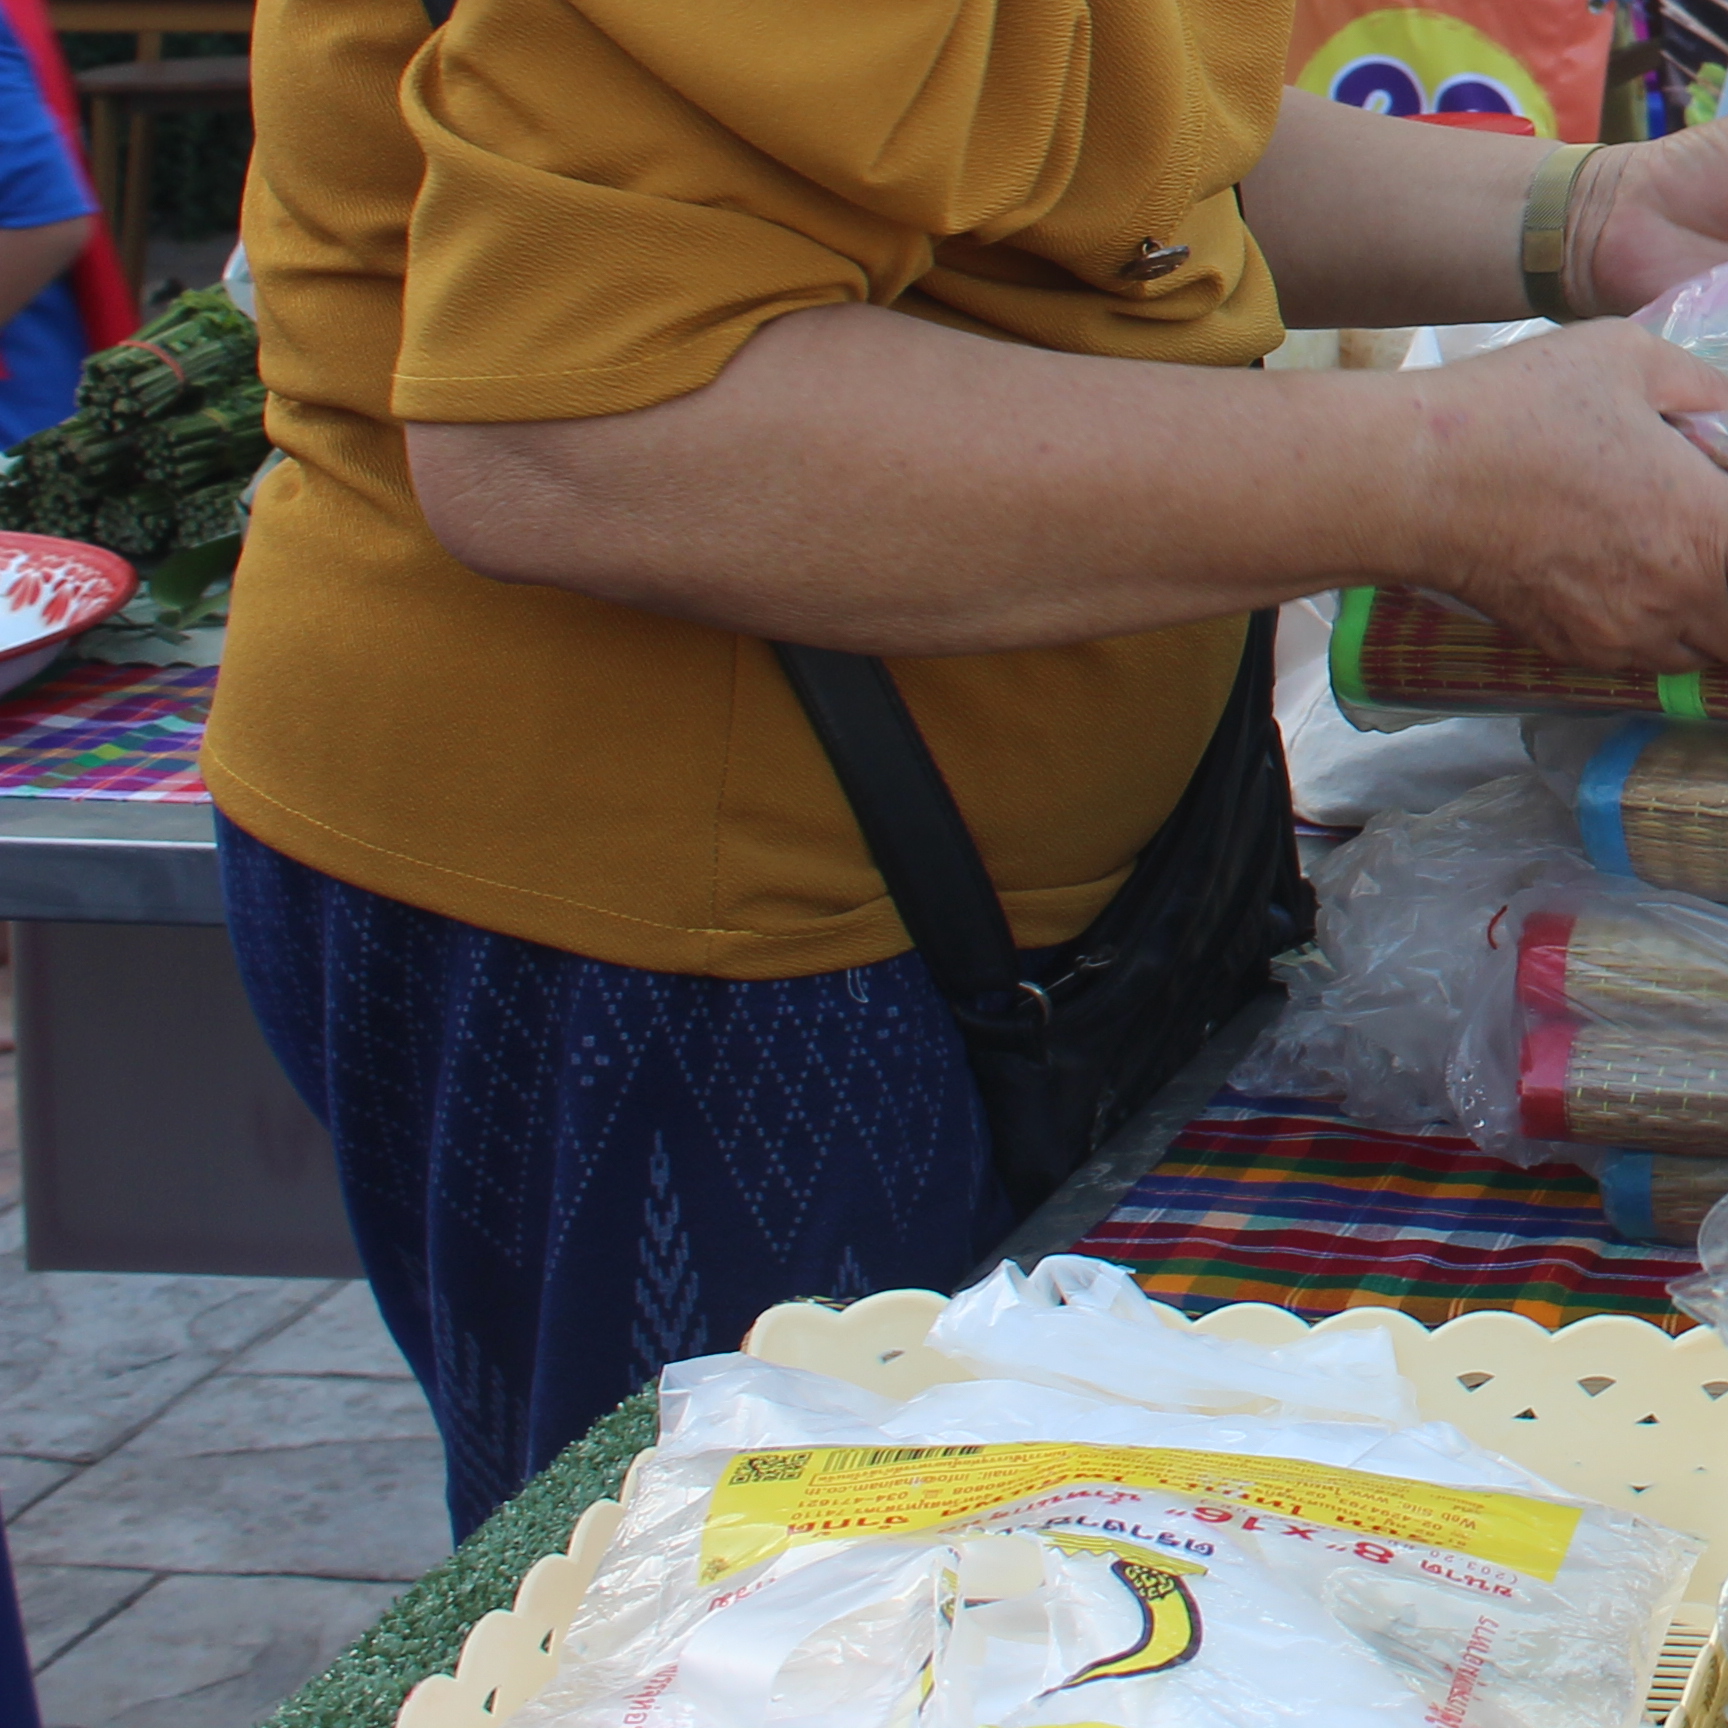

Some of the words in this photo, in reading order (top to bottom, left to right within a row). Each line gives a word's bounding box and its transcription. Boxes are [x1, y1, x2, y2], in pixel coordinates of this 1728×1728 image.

[787, 1515, 909, 1538] จำกัด
[1440, 1512, 1477, 1531] Web
[1420, 1560, 1512, 1598] ขนาด
